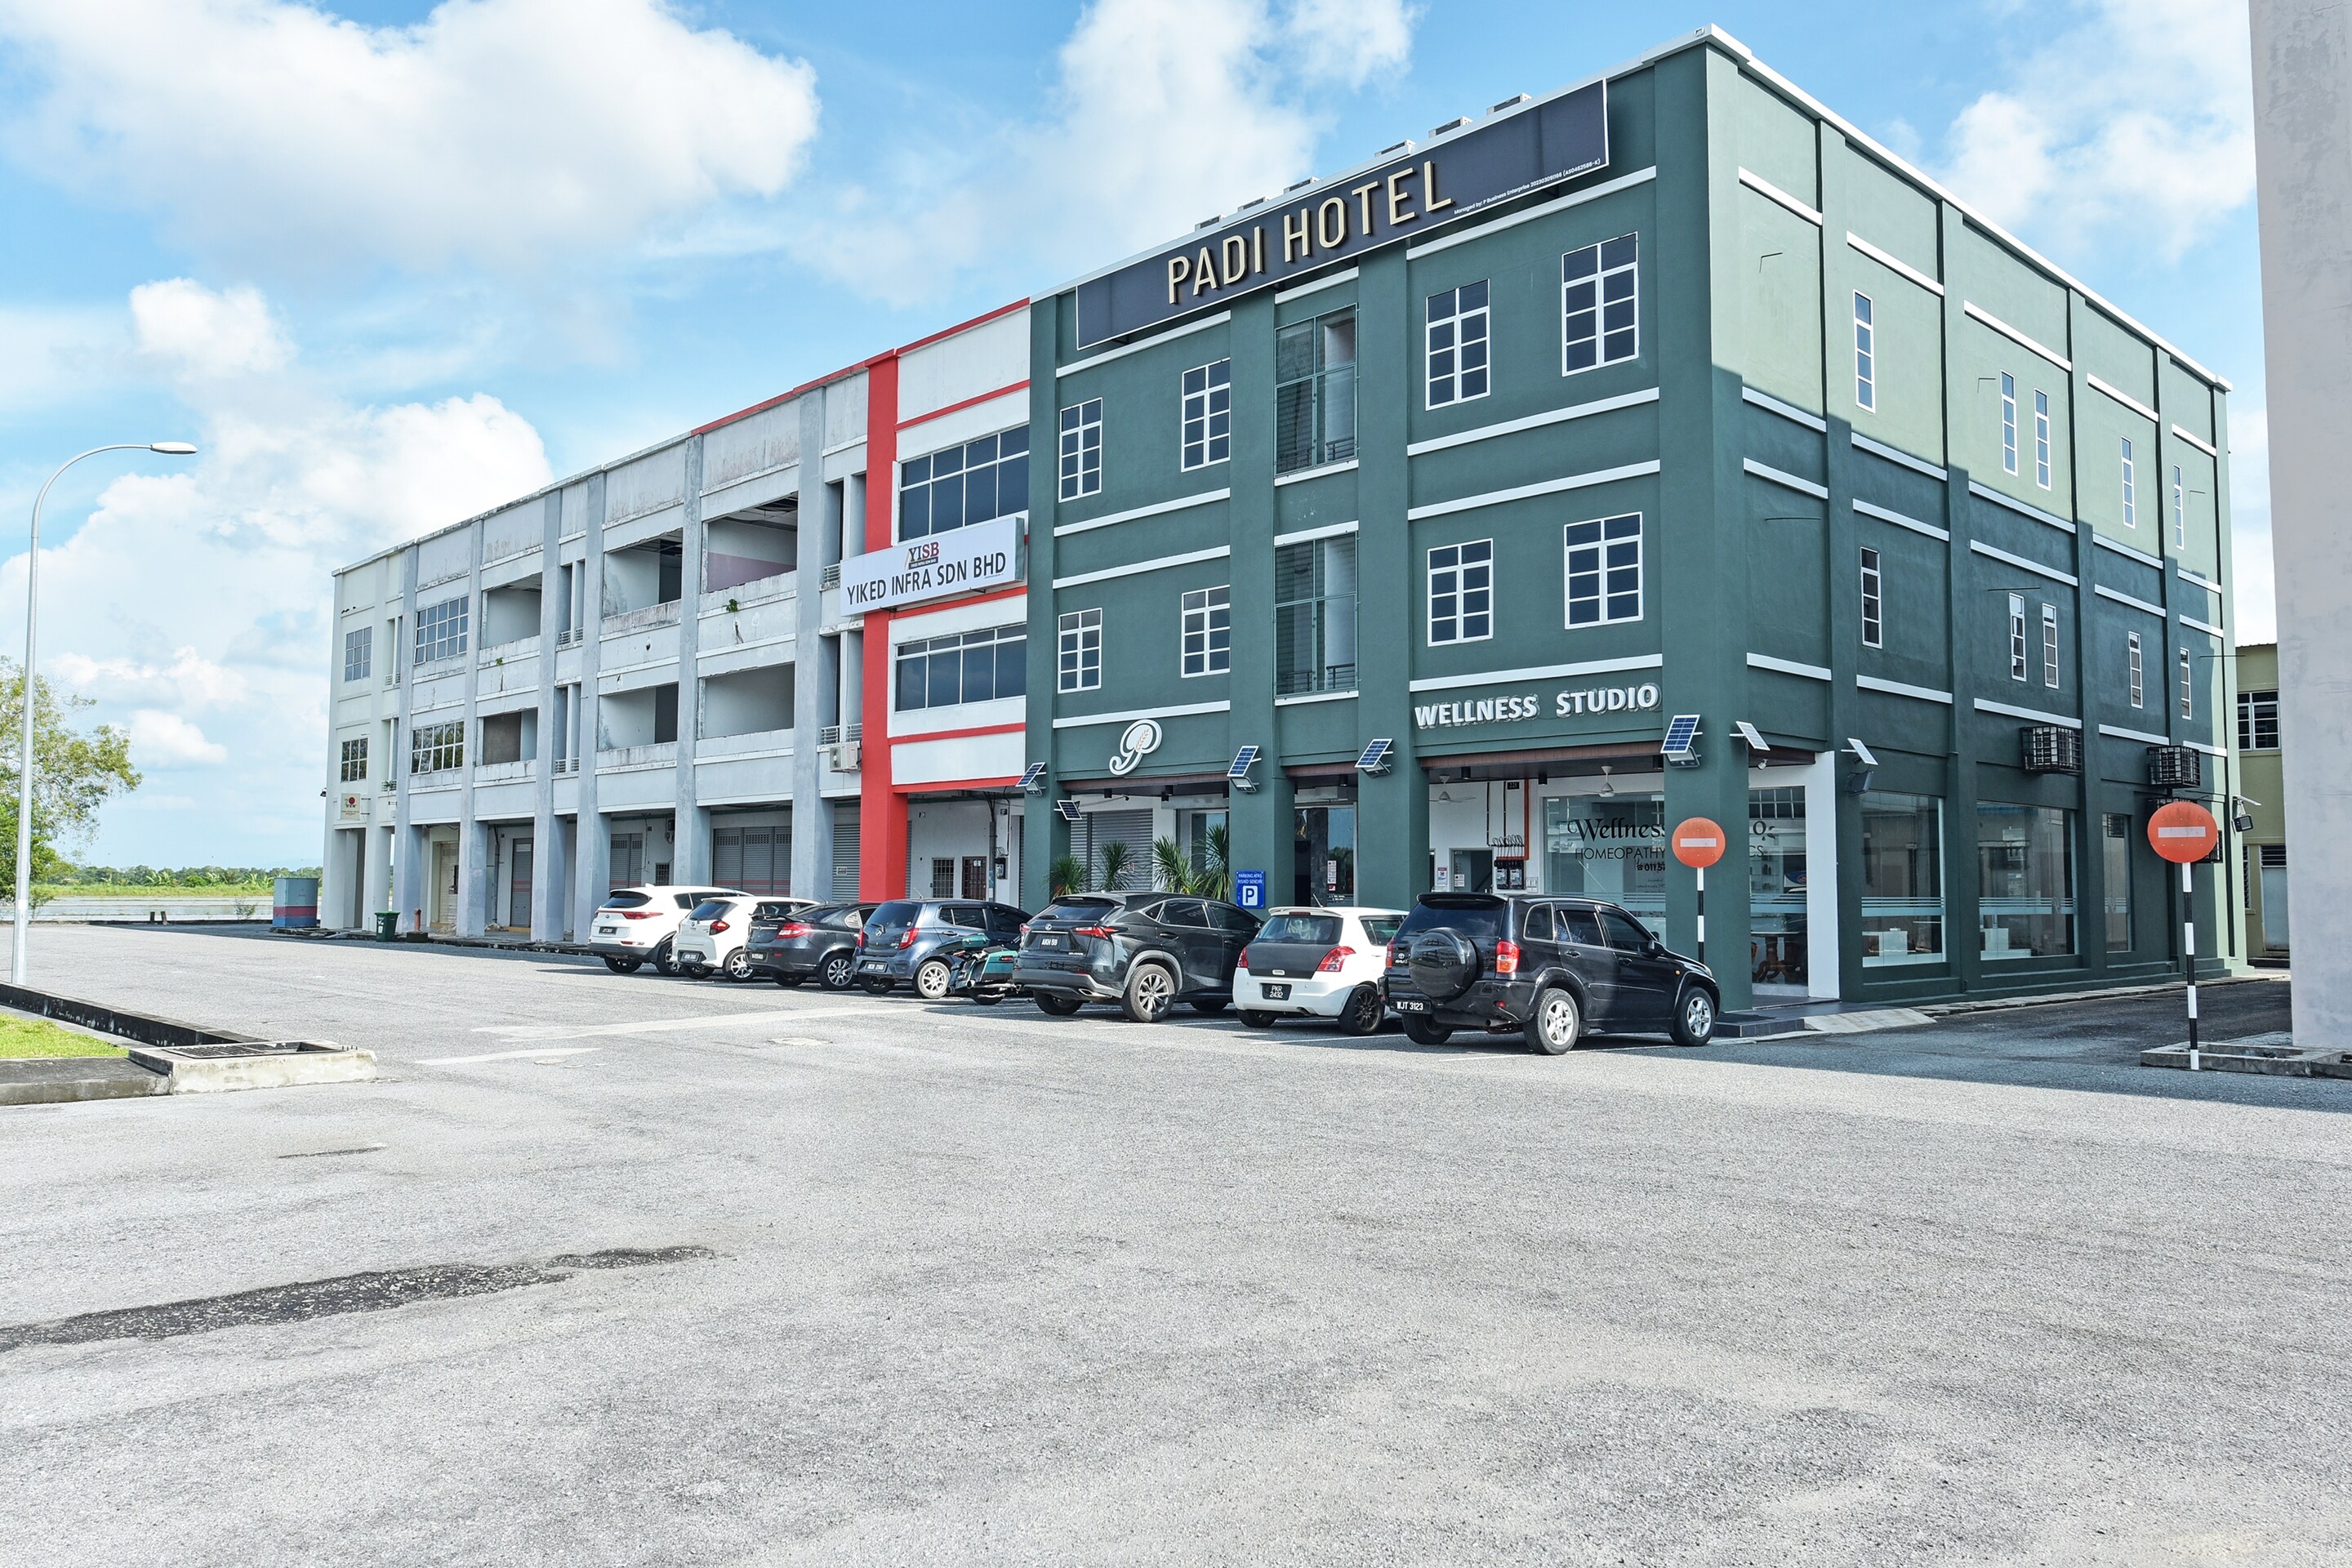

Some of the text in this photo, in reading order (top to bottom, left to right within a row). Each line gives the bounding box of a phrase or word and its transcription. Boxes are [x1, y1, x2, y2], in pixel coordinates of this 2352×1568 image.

[1454, 203, 1476, 215] Managed
[1487, 192, 1507, 203] Business
[1507, 184, 1530, 196] Enterprise
[1168, 160, 1453, 305] PADI HOTEL
[908, 541, 939, 562] YISB
[847, 552, 1006, 605] YIKED INFRA SDN BHD
[1414, 685, 1659, 728] WELLNESS STUDIO
[1245, 888, 1254, 903] P
[1396, 1001, 1423, 1011] WJT 3123
